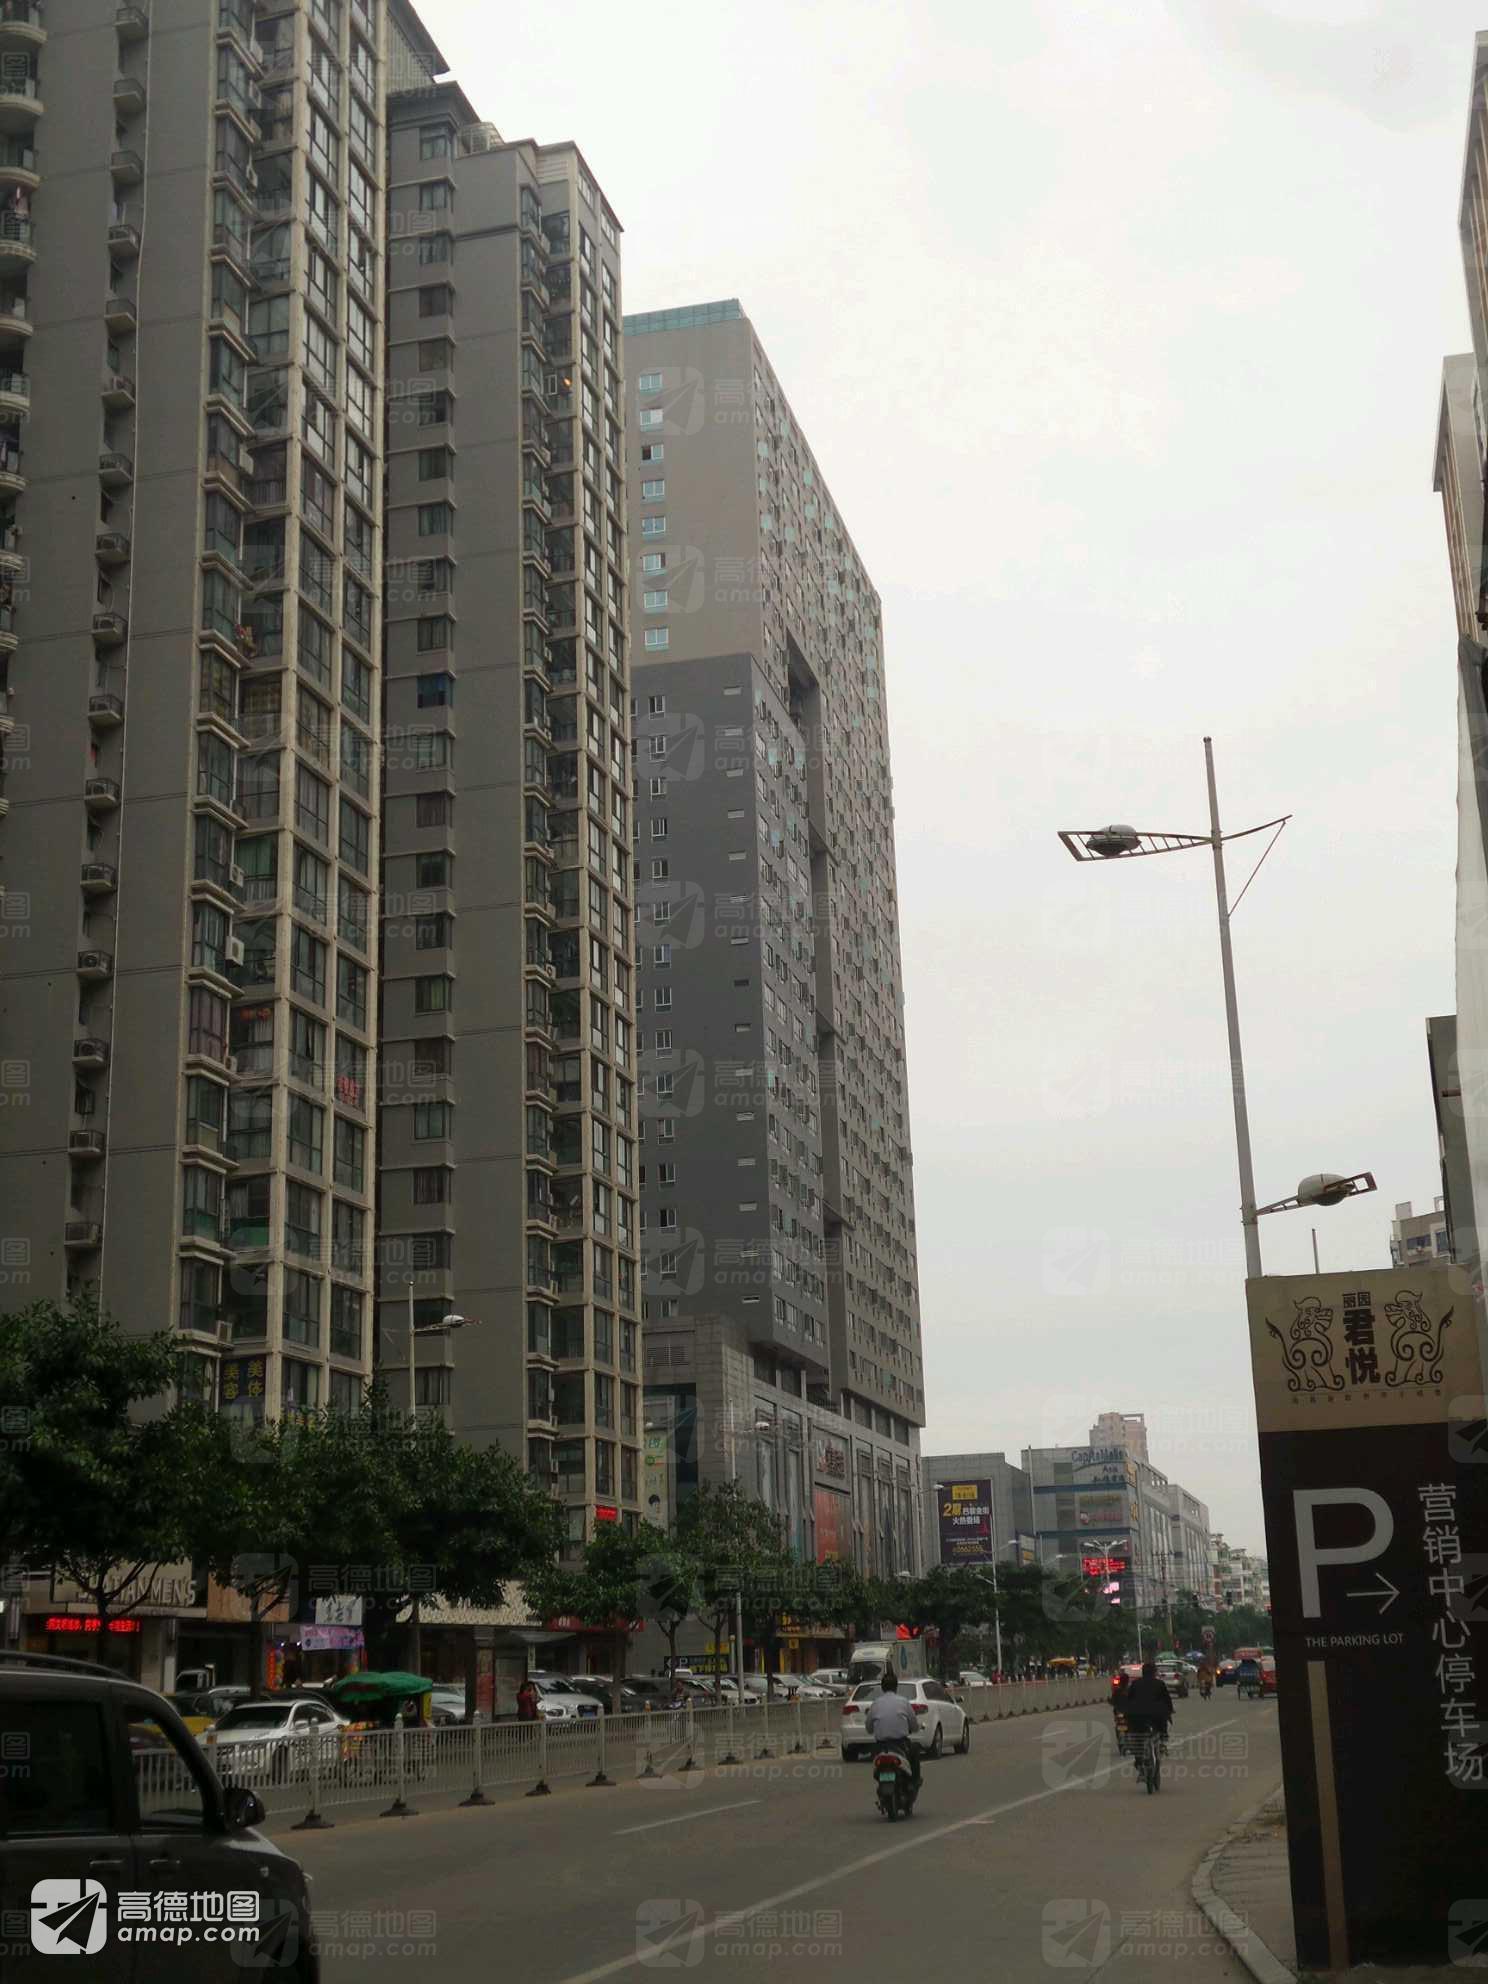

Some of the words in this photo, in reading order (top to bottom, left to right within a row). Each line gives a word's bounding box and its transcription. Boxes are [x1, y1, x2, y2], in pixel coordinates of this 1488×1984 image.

[1342, 1291, 1371, 1308] 丽园
[1343, 1309, 1381, 1385] 君悦
[1293, 1487, 1394, 1618] P
[1305, 1637, 1327, 1648] THE
[1330, 1633, 1380, 1647] PARKING
[1383, 1632, 1405, 1645] LOT
[1417, 1482, 1483, 1781] 营销中心停车场
